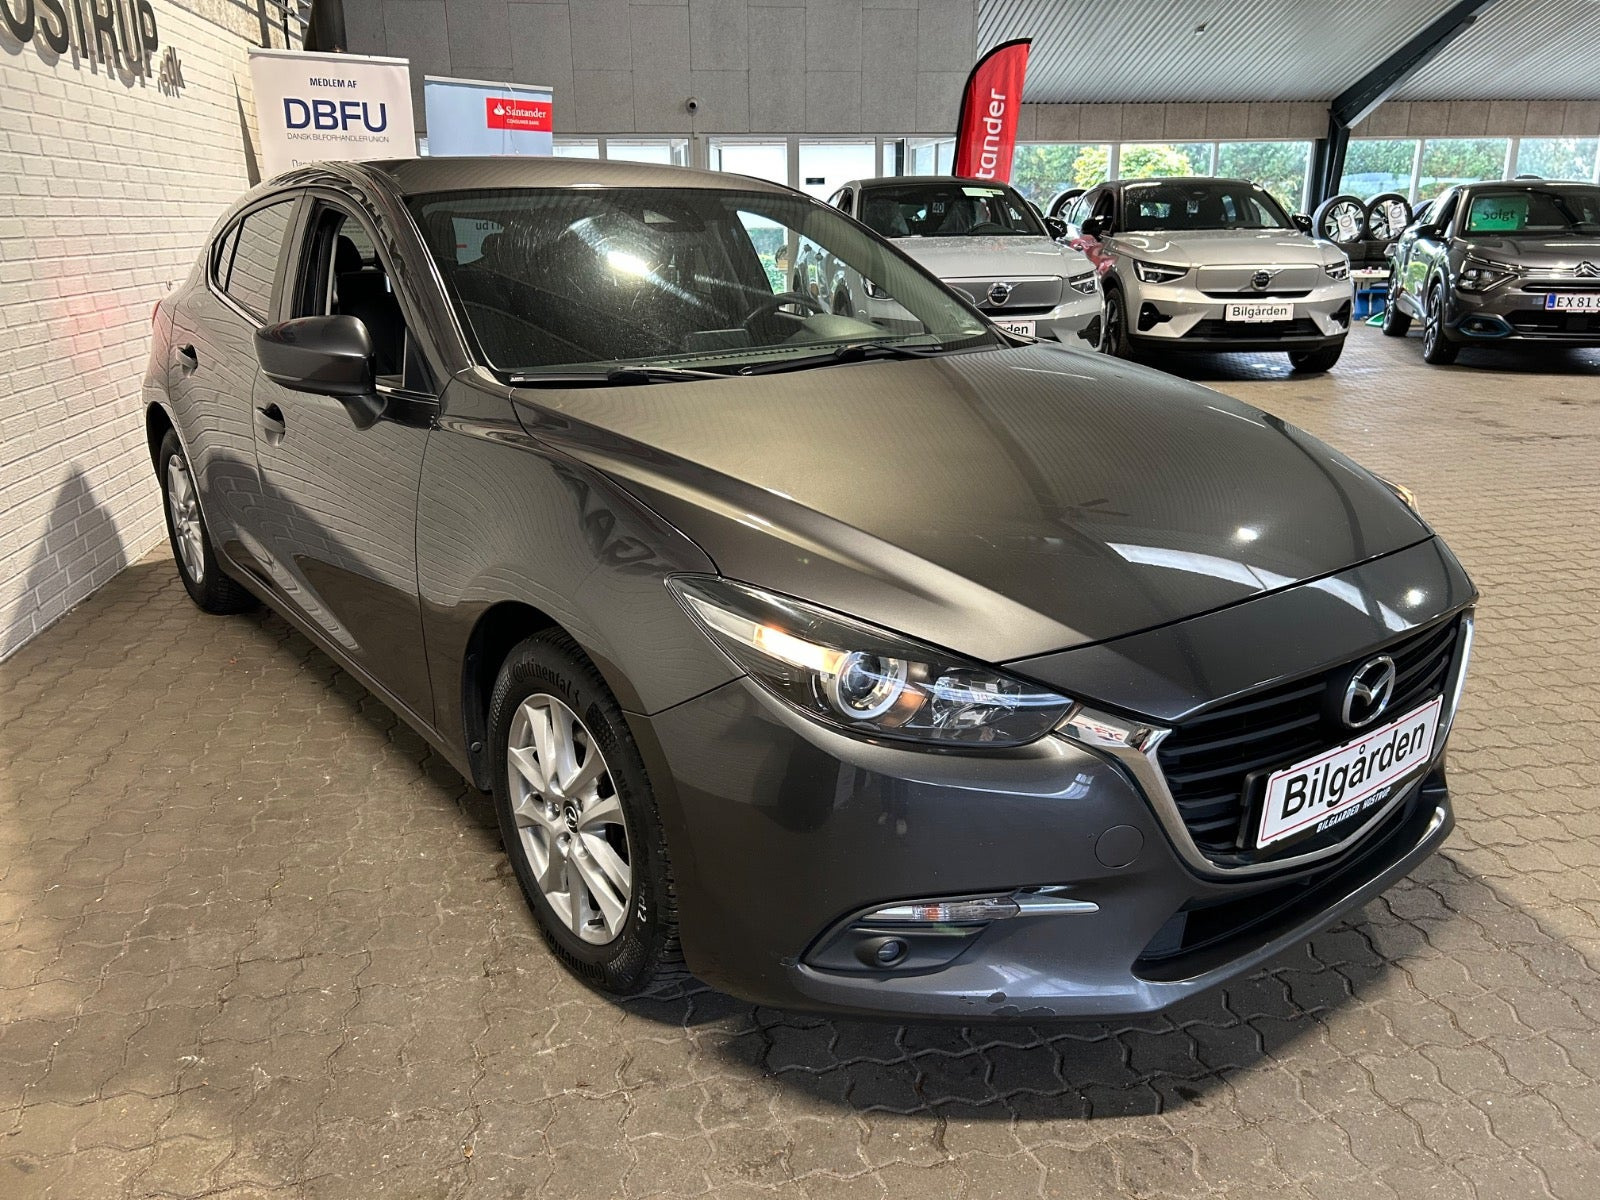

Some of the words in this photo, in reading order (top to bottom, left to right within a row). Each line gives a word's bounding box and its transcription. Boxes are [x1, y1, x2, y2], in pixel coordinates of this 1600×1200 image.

[309, 77, 345, 88] MEDLEM
[347, 80, 357, 89] AF
[283, 97, 387, 133] DBFU
[505, 105, 547, 119] Santander
[287, 132, 312, 140] DANSK
[313, 134, 367, 142] BILFORHANDLER
[975, 88, 1006, 179] tander
[1482, 208, 1516, 222] Solgt
[1556, 297, 1574, 308] EX
[1577, 297, 1592, 308] 81
[1232, 305, 1287, 319] Bilgården
[512, 660, 572, 699] Continental
[1281, 721, 1426, 820] Bilgården
